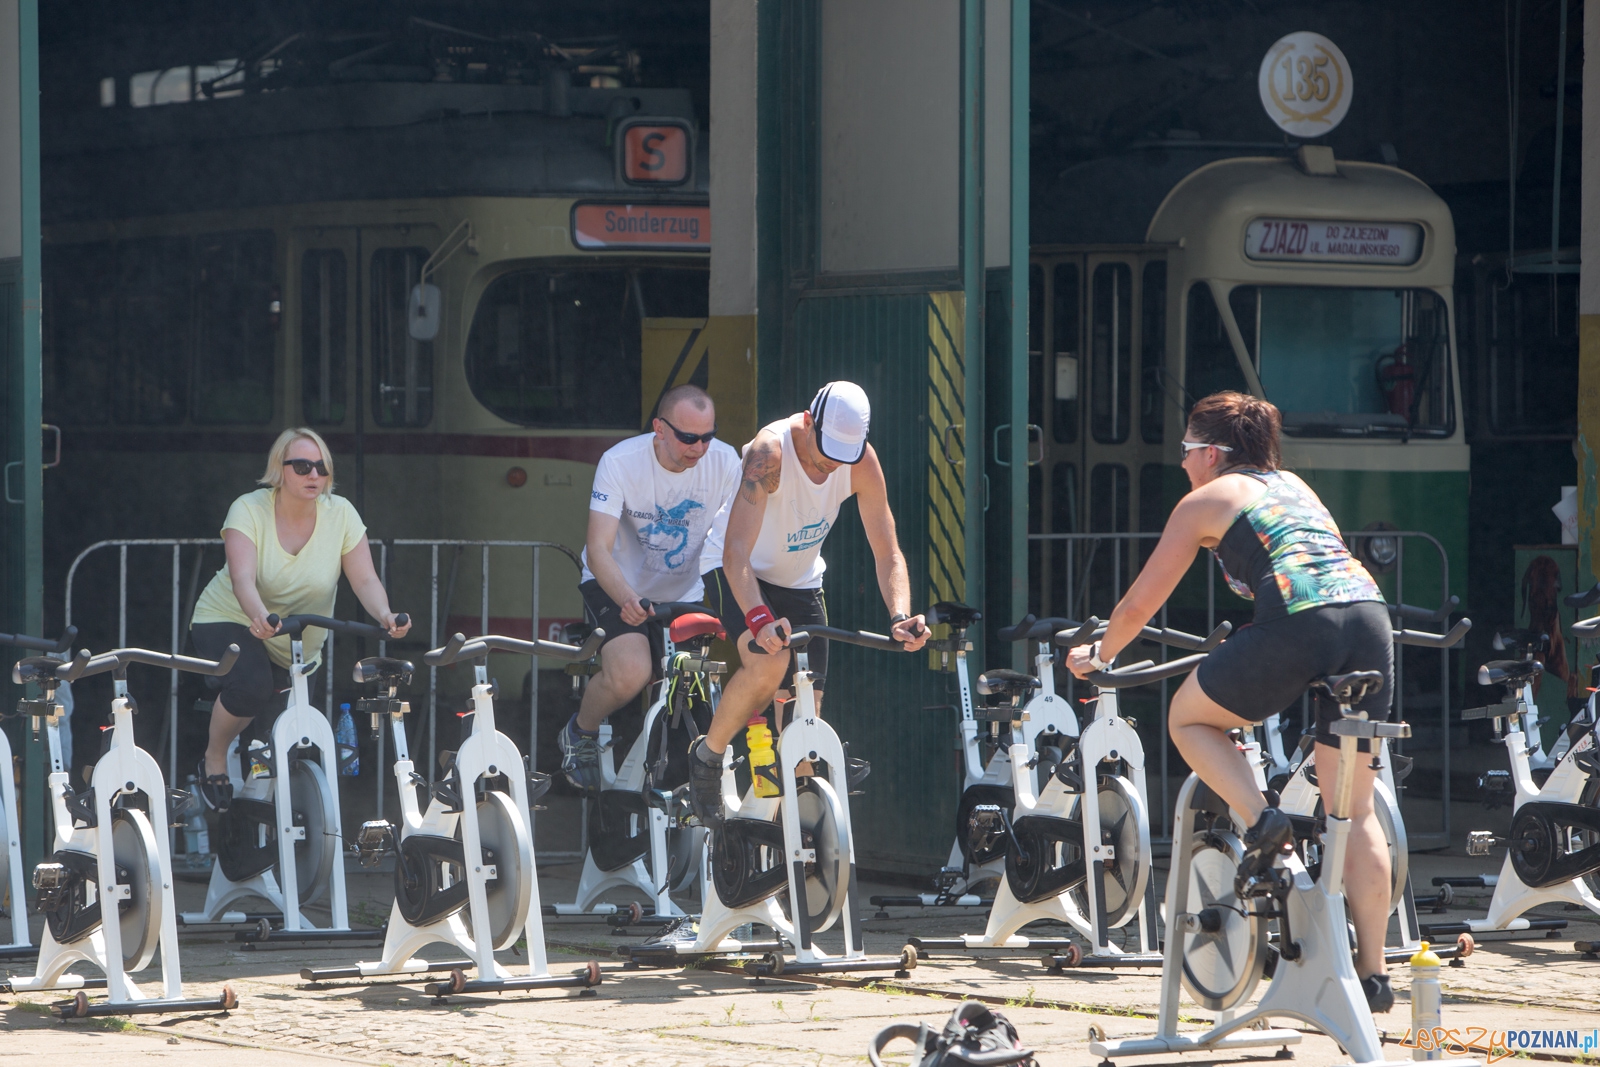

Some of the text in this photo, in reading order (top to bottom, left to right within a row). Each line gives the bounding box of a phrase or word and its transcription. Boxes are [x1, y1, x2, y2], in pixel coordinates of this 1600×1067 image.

[1281, 56, 1331, 101] 135
[639, 132, 665, 171] S
[604, 210, 699, 240] Sonderzug
[1325, 226, 1389, 242] DO ZAJEZDNI
[1259, 222, 1309, 254] ZJAZD
[1310, 241, 1400, 257] UL. MADALIŃSKIEGO
[787, 522, 830, 543] WILDA
[1044, 695, 1053, 703] 49
[805, 718, 814, 726] 14
[1108, 718, 1114, 726] 2
